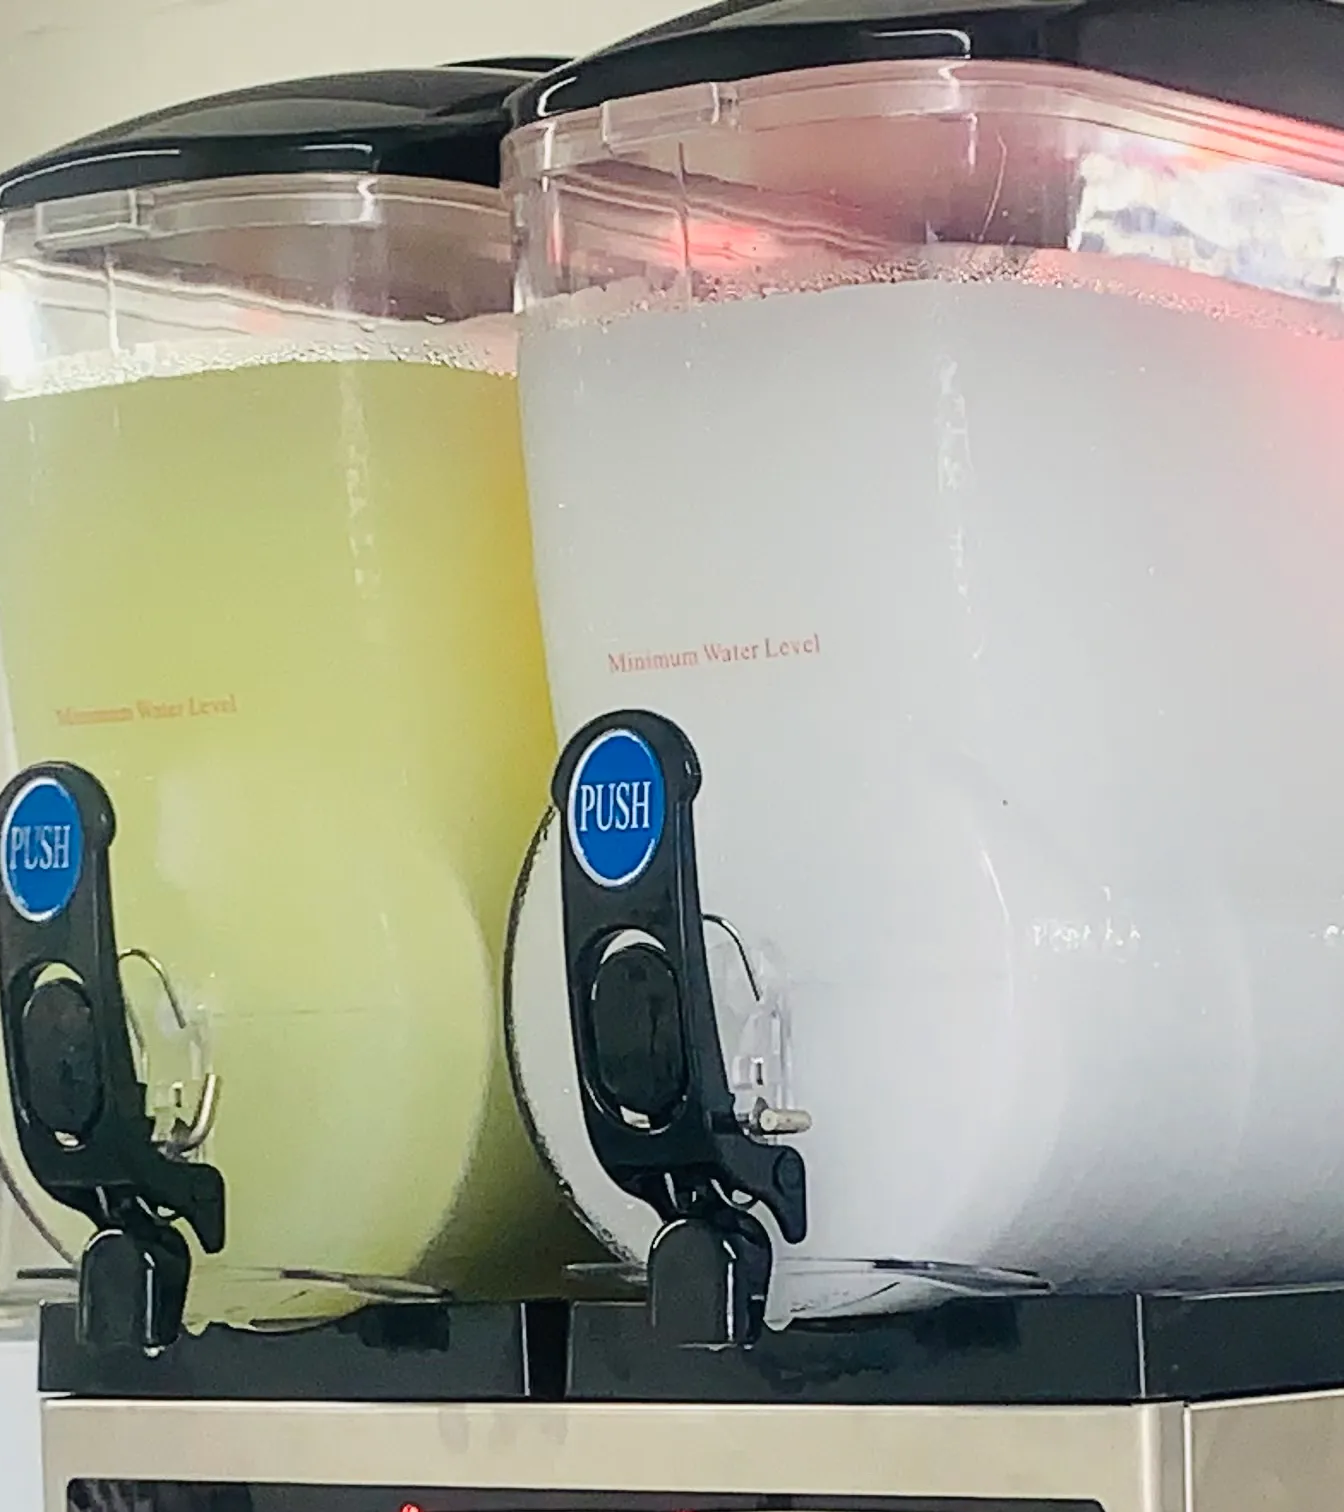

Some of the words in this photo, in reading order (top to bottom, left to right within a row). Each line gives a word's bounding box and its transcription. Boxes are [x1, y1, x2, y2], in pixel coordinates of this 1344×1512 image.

[608, 651, 698, 674] Minimum
[704, 643, 759, 662] Water
[764, 633, 821, 658] Level
[137, 700, 184, 719] Water
[188, 694, 238, 716] Level
[579, 781, 651, 832] PUSH
[9, 824, 70, 870] PUSH
